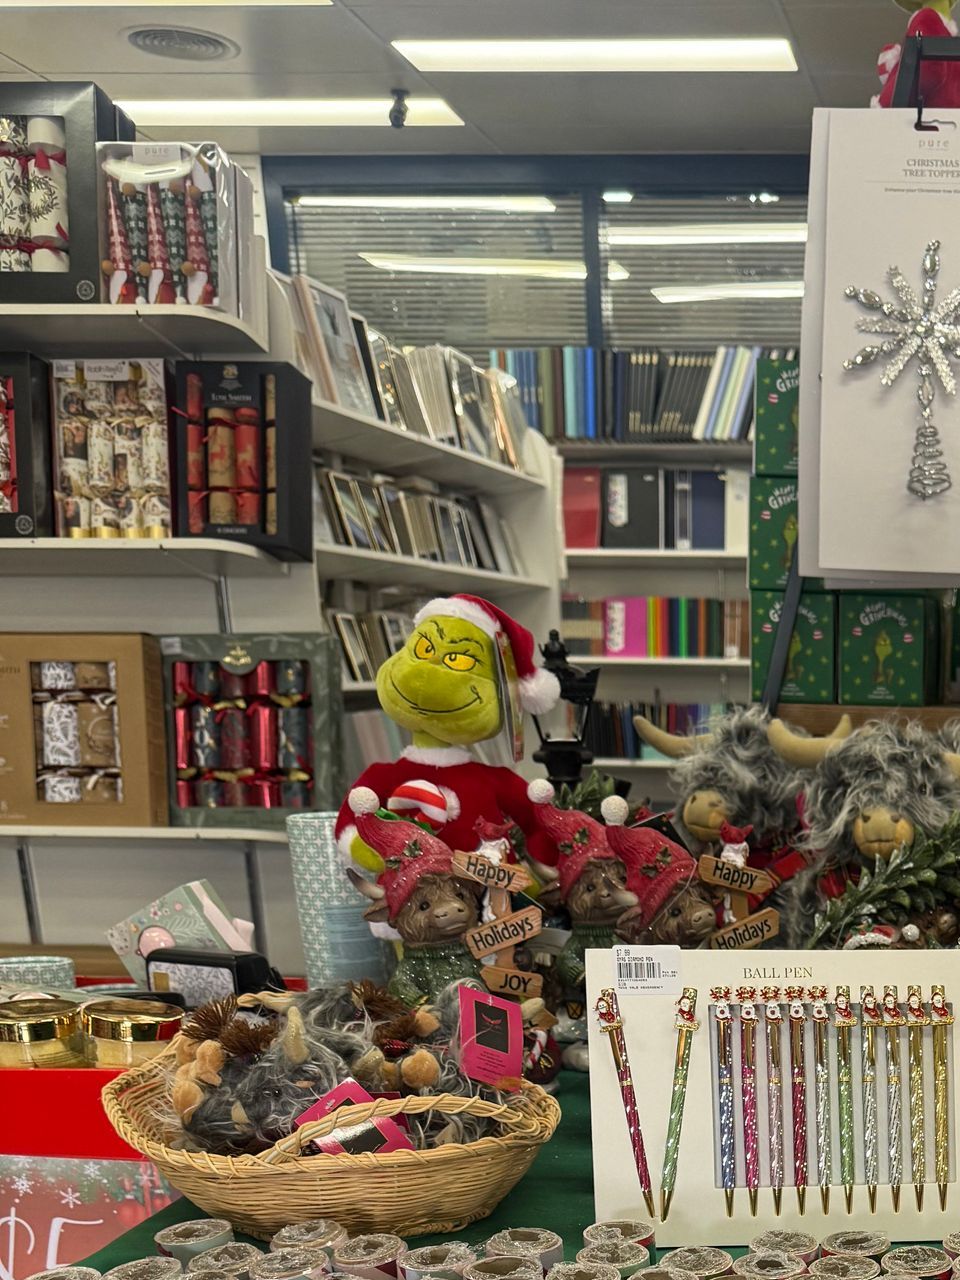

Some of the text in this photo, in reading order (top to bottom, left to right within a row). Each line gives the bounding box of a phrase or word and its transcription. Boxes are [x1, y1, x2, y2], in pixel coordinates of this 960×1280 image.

[919, 140, 949, 149] pure
[902, 169, 925, 177] TREE
[907, 159, 960, 168] CHRISTMAS
[465, 855, 516, 888] Happy
[713, 861, 758, 889] Happy
[471, 916, 534, 951] Holidays
[715, 918, 772, 949] Holidays
[500, 973, 532, 992] JOY
[743, 967, 813, 979] BALL PEN
